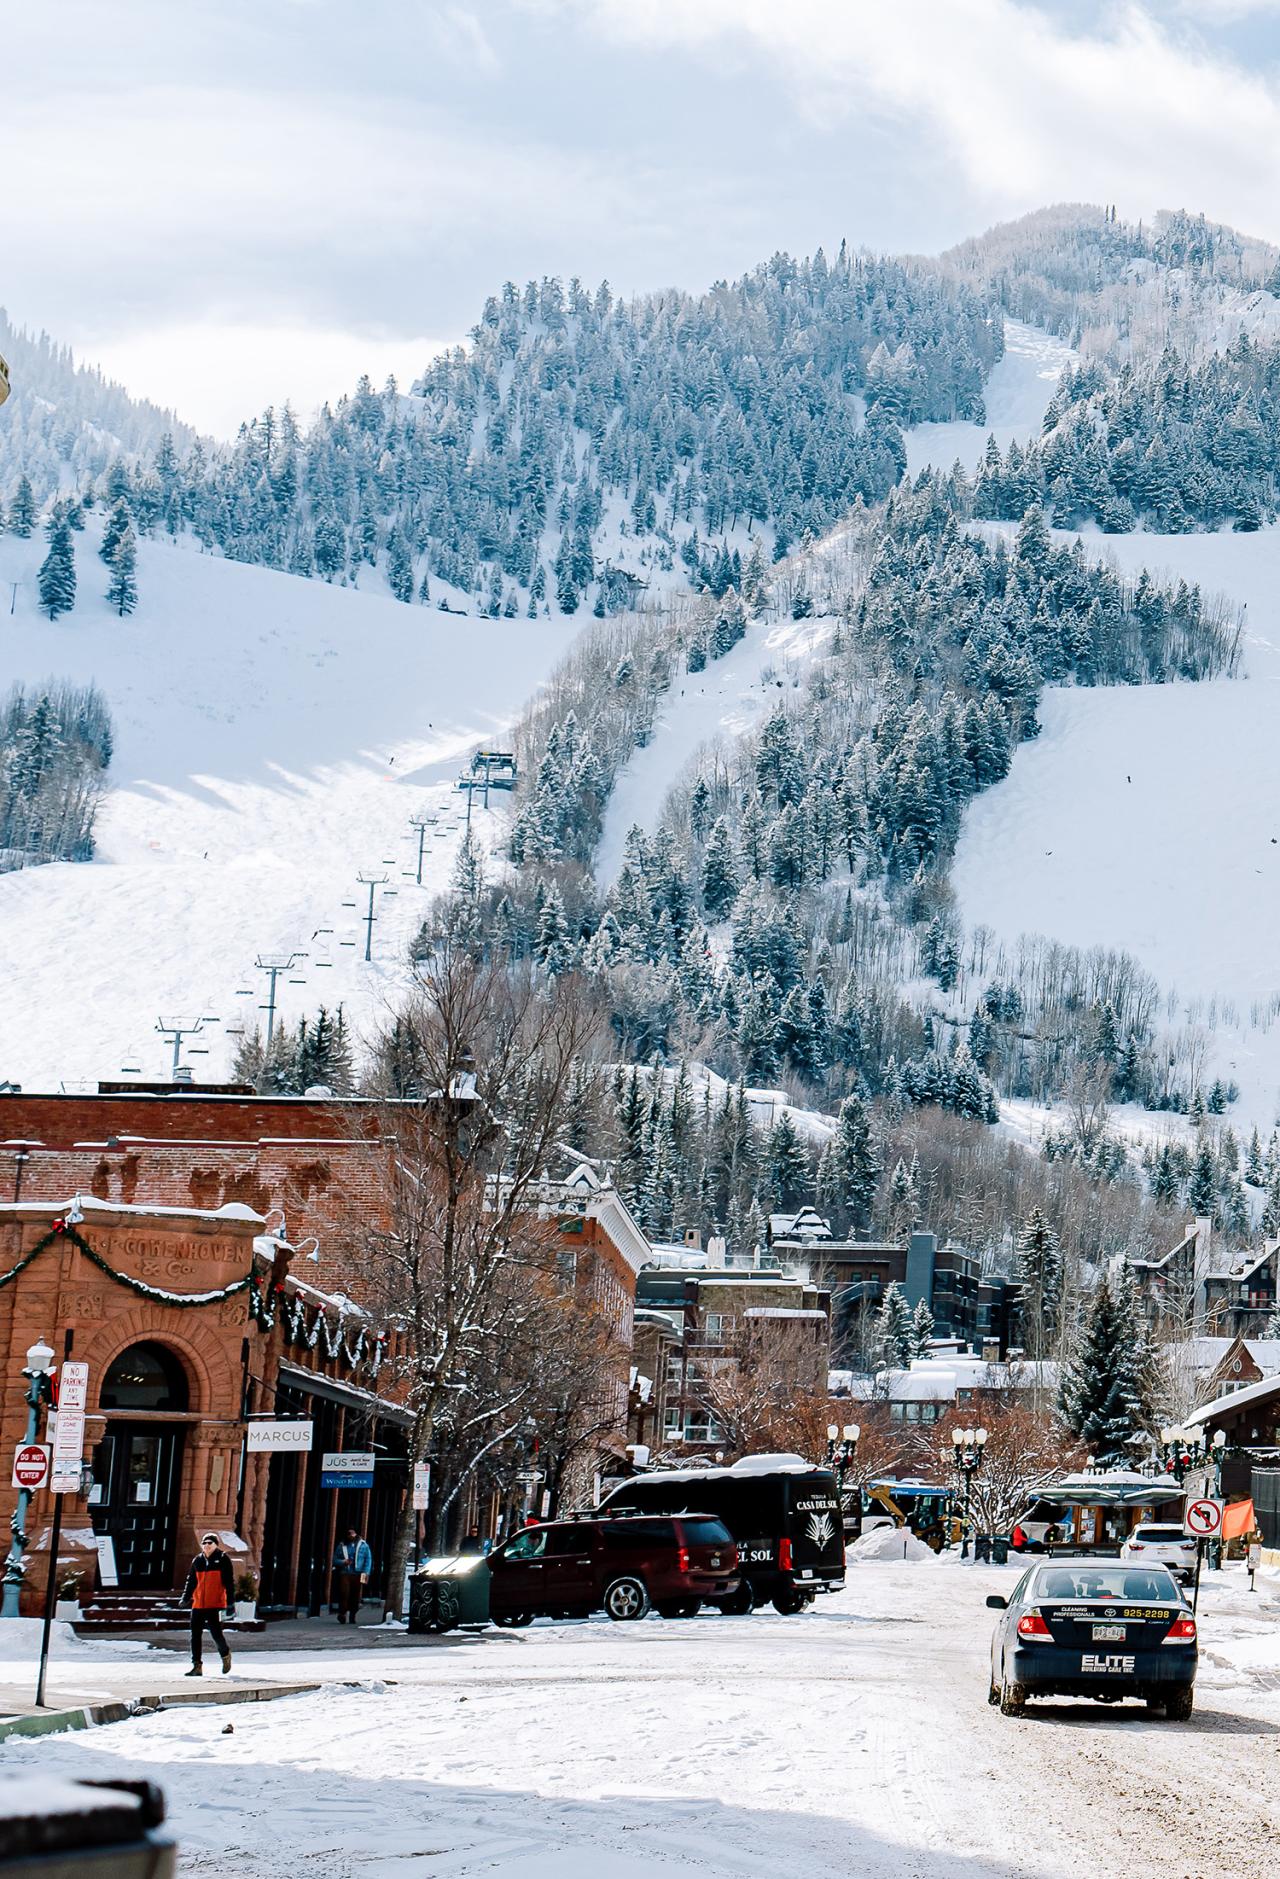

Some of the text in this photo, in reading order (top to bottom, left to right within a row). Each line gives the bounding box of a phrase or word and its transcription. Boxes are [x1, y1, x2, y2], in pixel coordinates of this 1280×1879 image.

[250, 1431, 310, 1442] MARCUS
[20, 1471, 40, 1479] ENTER
[796, 1500, 838, 1510] CASA DEL SOL
[750, 1550, 774, 1561] SOL
[1123, 1609, 1170, 1618] 925-2298
[1082, 1655, 1135, 1667] ELITE
